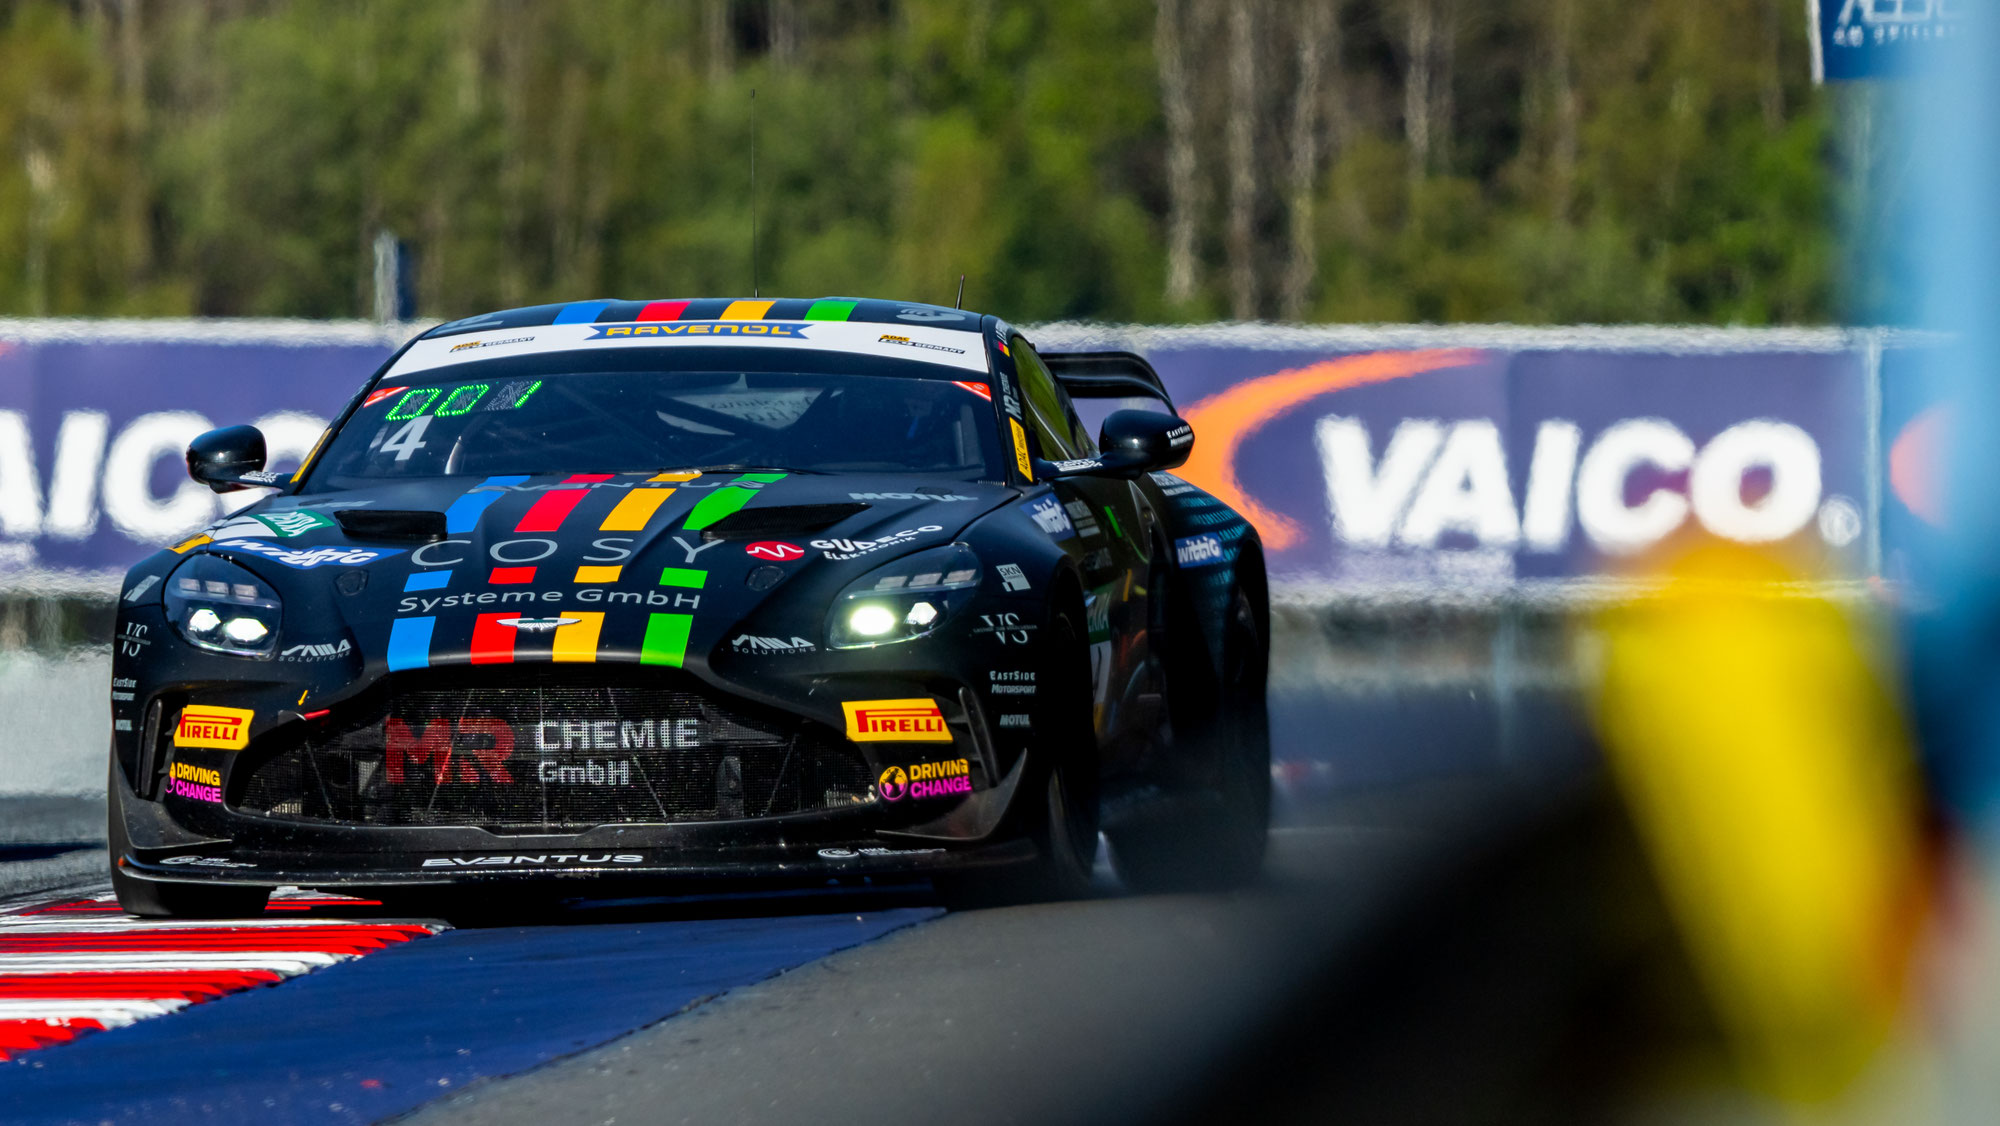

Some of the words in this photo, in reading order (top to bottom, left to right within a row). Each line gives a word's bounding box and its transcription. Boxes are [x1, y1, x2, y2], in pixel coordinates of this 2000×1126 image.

[606, 324, 792, 336] RAVENOL
[380, 415, 434, 461] 4
[1314, 416, 1822, 554] VAICO
[410, 535, 725, 567] COSY
[810, 525, 943, 552] GUDECO
[1000, 565, 1022, 577] SKN
[397, 588, 563, 613] Systeme
[575, 588, 700, 610] GmbH
[179, 713, 243, 741] PIRELLI
[855, 707, 943, 733] PIRELLI
[385, 717, 515, 785] MR
[535, 718, 700, 750] CHEMIE
[177, 762, 221, 786] DRIVING
[539, 758, 629, 785] GmbH
[909, 758, 970, 781] DRIVING
[176, 780, 222, 803] CHANGE
[910, 775, 972, 798] CHANGE
